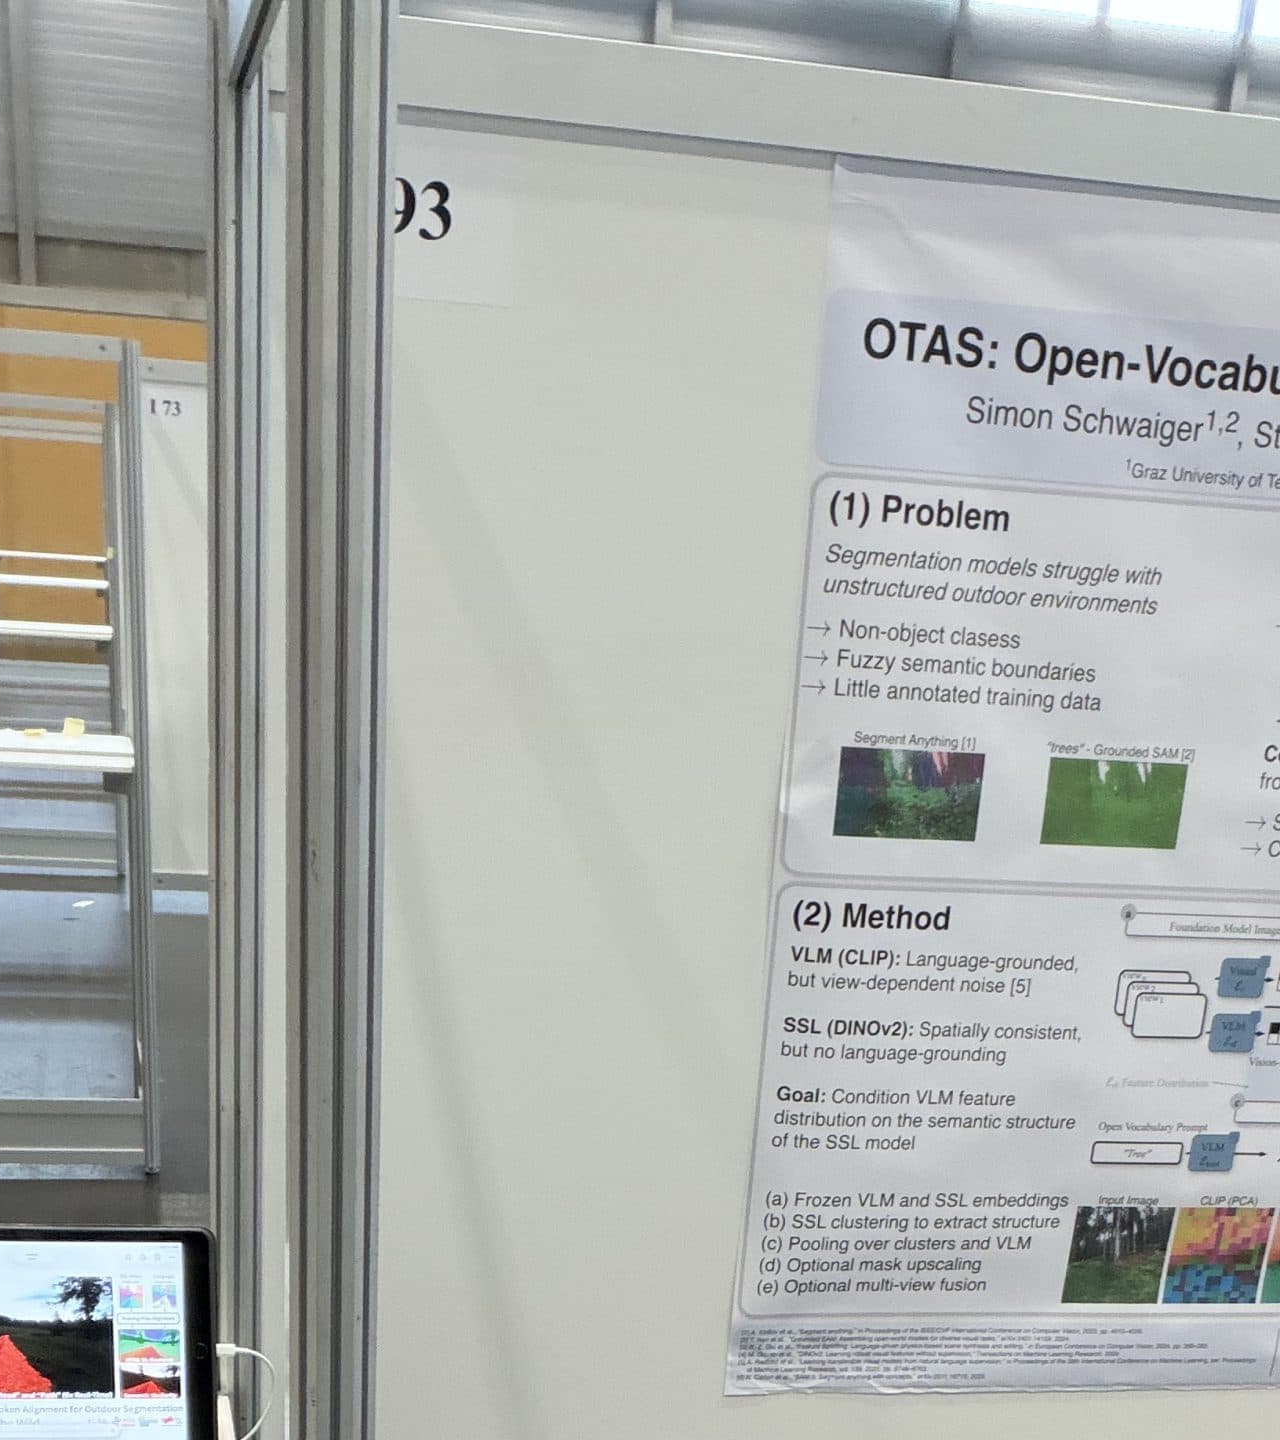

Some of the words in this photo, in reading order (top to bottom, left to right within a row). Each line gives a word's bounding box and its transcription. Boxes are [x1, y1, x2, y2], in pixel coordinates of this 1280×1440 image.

[863, 317, 998, 369] OTAS:
[162, 400, 181, 416] 73
[965, 395, 1053, 430] Simon
[1171, 465, 1245, 491] University
[1247, 472, 1264, 489] of
[829, 490, 870, 528] (1)
[881, 494, 1010, 532] Problem
[824, 542, 962, 572] Segmentation
[966, 556, 1038, 578] models
[1041, 561, 1120, 587] struggle
[1125, 565, 1163, 586] with
[823, 576, 949, 601] unstructured
[951, 584, 1027, 606] outdoor
[1029, 590, 1158, 615] environments
[839, 618, 945, 647] Non-object
[949, 626, 1021, 650] clasess
[836, 647, 896, 676] Fuzzy
[900, 656, 986, 676] semantic
[990, 657, 1096, 683] boundaries
[833, 677, 881, 699] Little
[886, 684, 982, 705] annotated
[986, 687, 1055, 714] training
[1059, 690, 1101, 712] data
[792, 899, 832, 934] (2)
[842, 902, 951, 931] Method
[790, 945, 833, 964] VLM
[837, 948, 901, 970] (CLIP):
[905, 950, 1077, 973] Language-grounded,
[787, 970, 816, 988] but
[820, 973, 956, 994] view-dependent
[959, 976, 1006, 993] noise
[1009, 977, 1032, 998] [5]
[782, 1016, 822, 1035] SSL
[826, 1018, 914, 1040] (DINOv2):
[918, 1020, 990, 1042] Spatially
[994, 1025, 1081, 1041] consistent,
[780, 1040, 808, 1058] but
[813, 1045, 836, 1059] no
[840, 1043, 1007, 1067] language-grounding
[758, 1256, 782, 1276] (d)
[786, 1256, 855, 1276] Optional
[858, 1257, 902, 1272] mask
[906, 1256, 982, 1274] upscaling
[756, 1278, 779, 1296] (e)
[783, 1277, 852, 1296] Optional
[855, 1276, 936, 1292] multi-view
[939, 1277, 987, 1292] fusion
